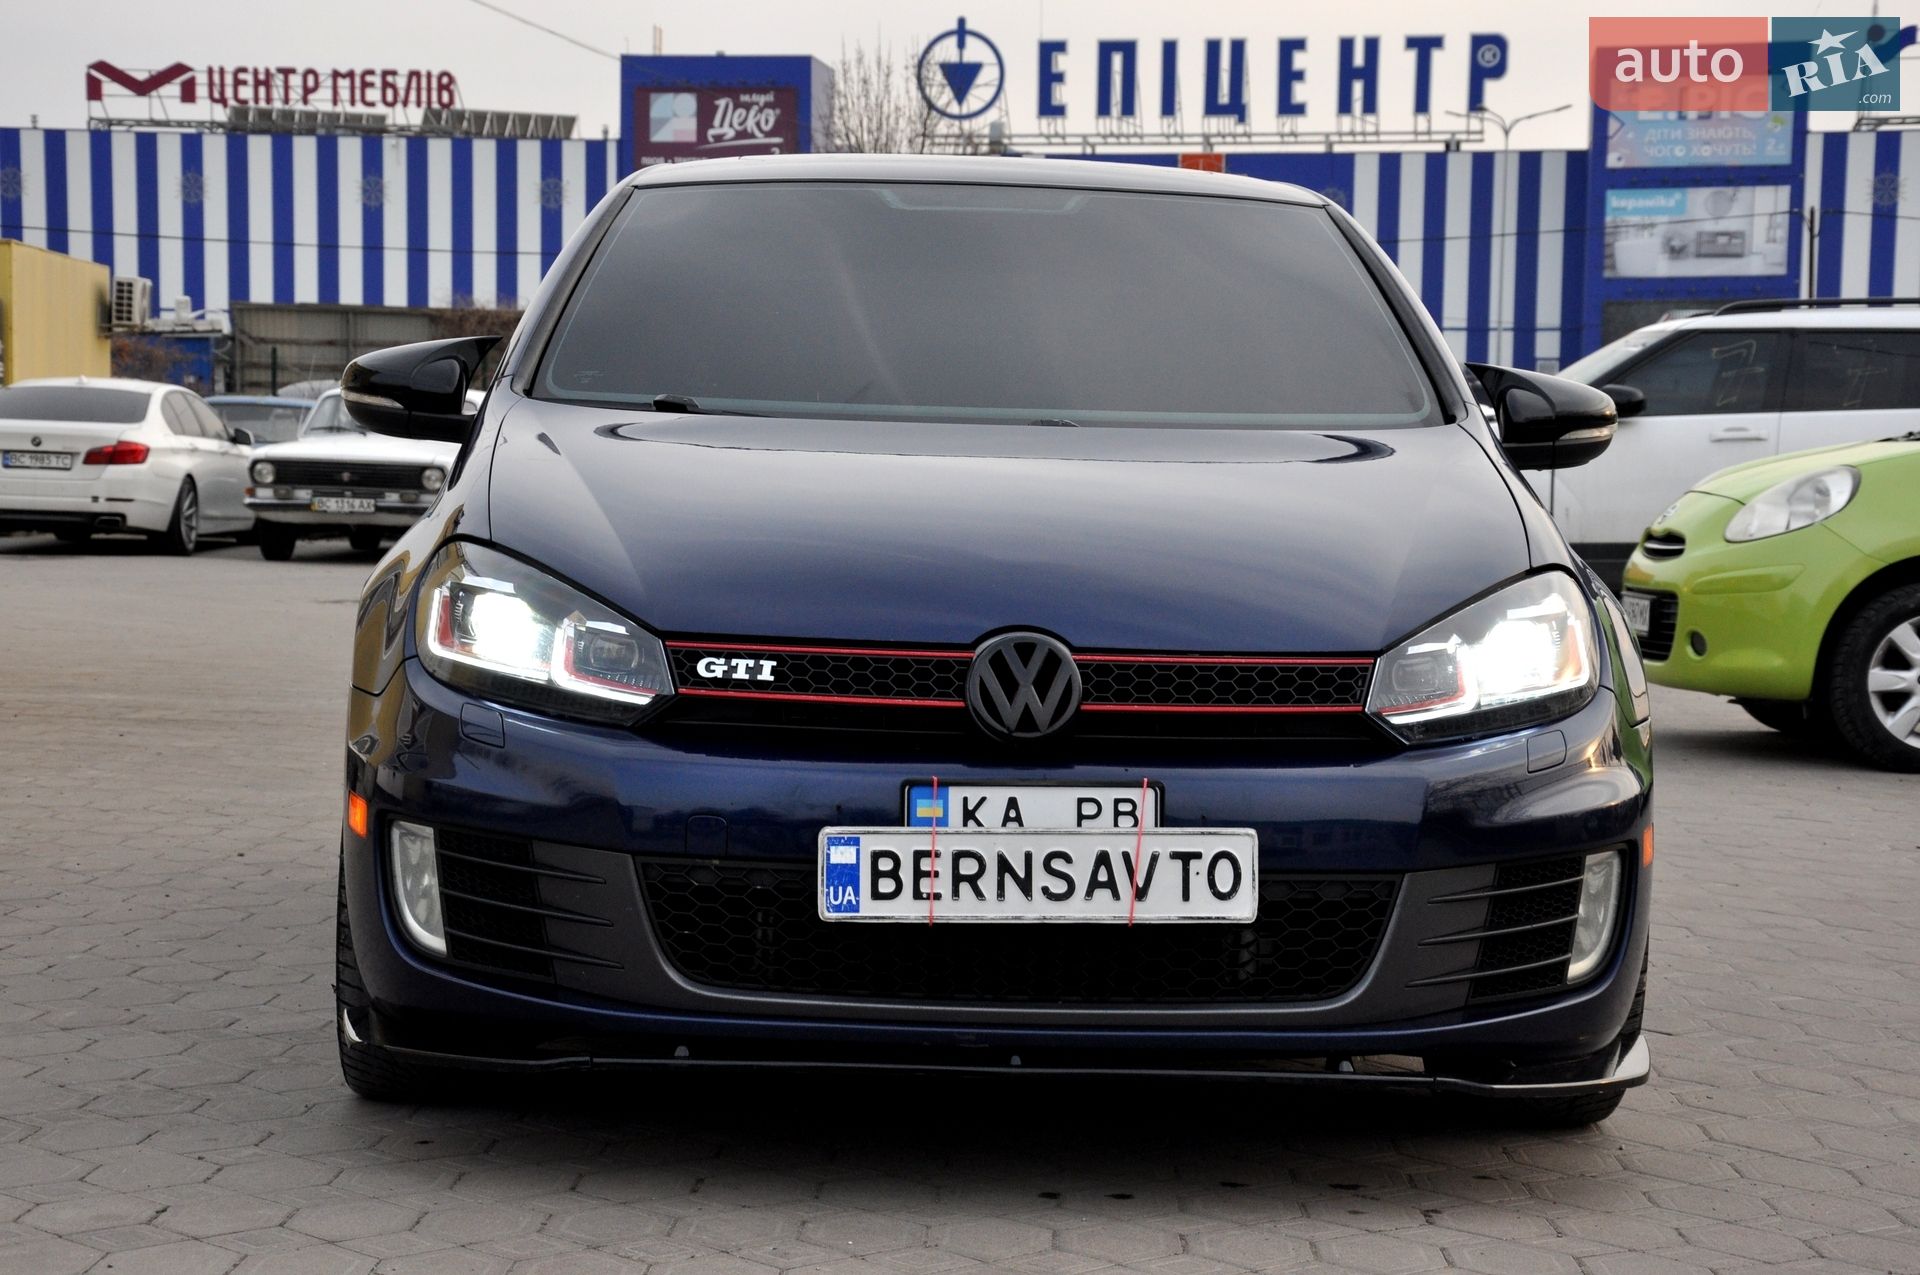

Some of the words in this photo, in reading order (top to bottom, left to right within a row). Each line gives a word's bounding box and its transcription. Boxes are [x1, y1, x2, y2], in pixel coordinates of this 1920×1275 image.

[207, 65, 320, 108] ЦЕНТР
[331, 68, 455, 109] МЕБЛІВ
[1037, 33, 1509, 124] ЕПІЦЕНТР
[696, 657, 777, 681] GTI
[829, 885, 857, 905] UA
[869, 849, 1243, 902] BERNSAVTO
